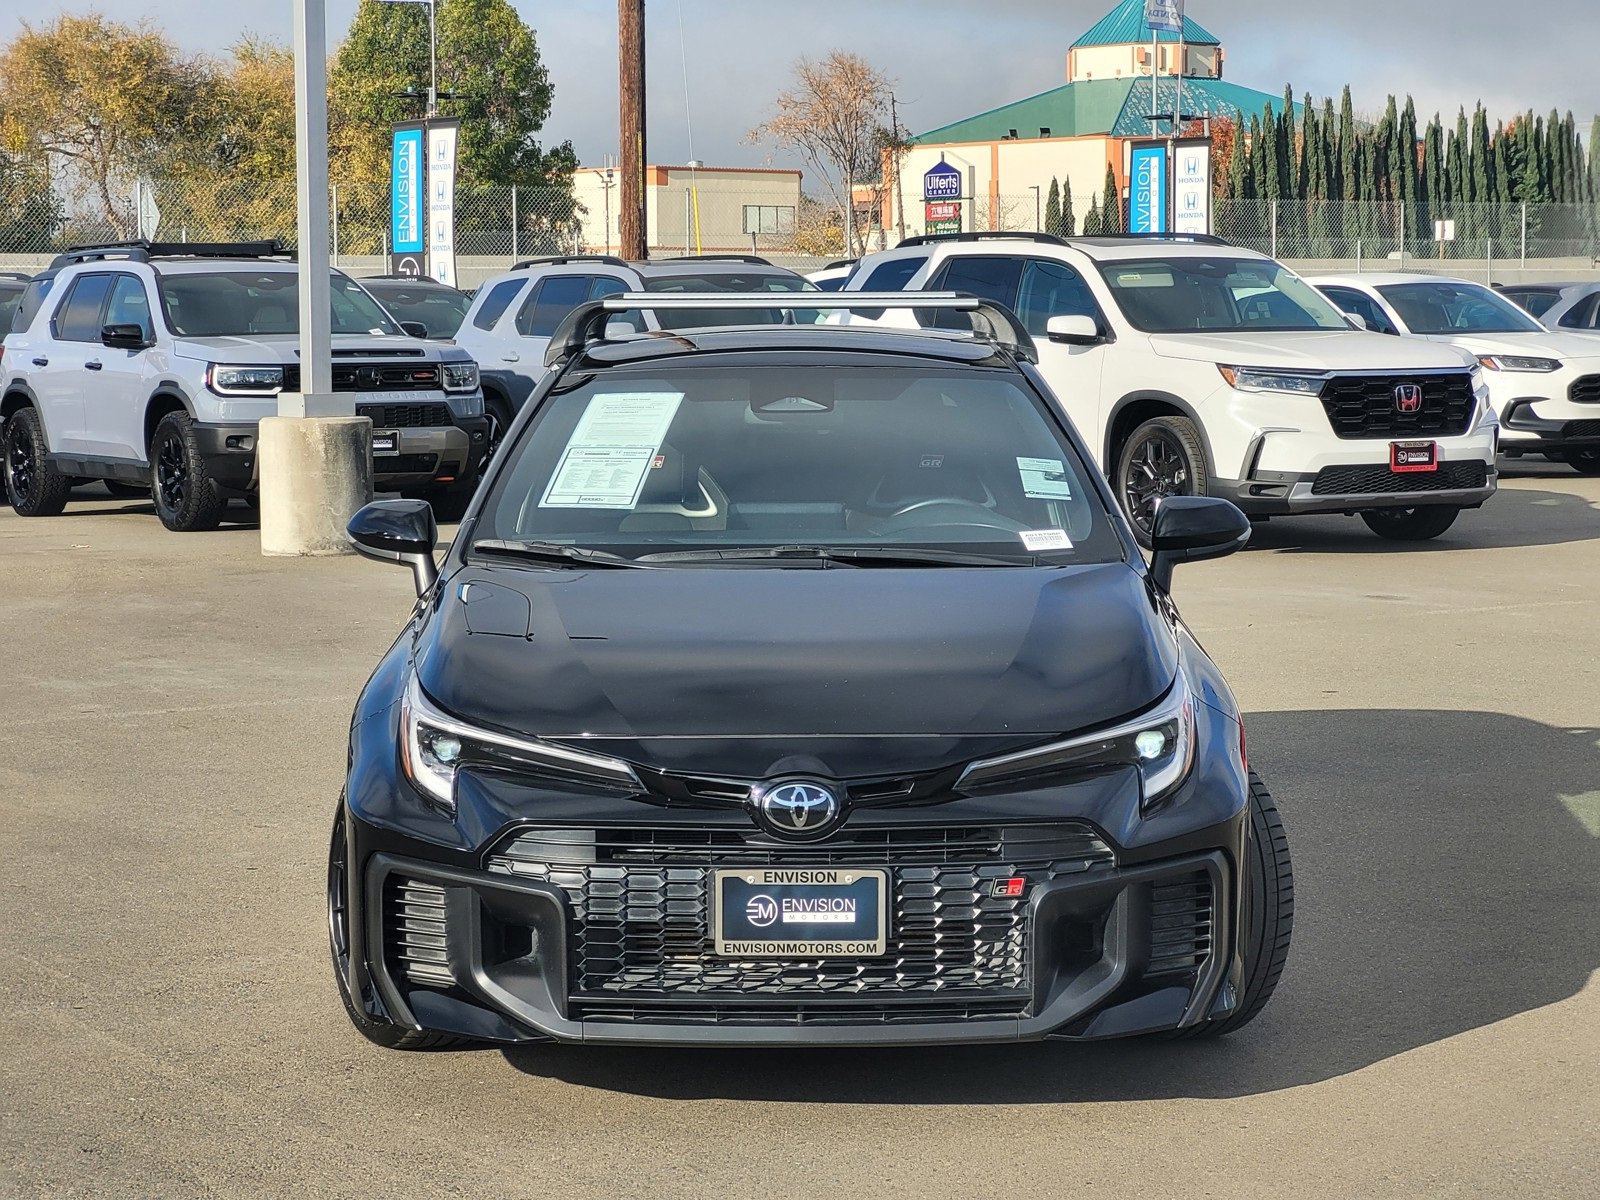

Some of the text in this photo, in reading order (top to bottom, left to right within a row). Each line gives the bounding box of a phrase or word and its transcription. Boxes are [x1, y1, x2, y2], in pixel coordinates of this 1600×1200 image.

[431, 163, 452, 171] HONDA
[927, 176, 957, 190] Ulferts
[398, 140, 410, 243] ENVISION
[1138, 157, 1150, 233] NVISION
[763, 871, 838, 883] ENVISION
[782, 898, 856, 912] ENVISION
[724, 943, 877, 954] ENVISIONMOTORS.COM
